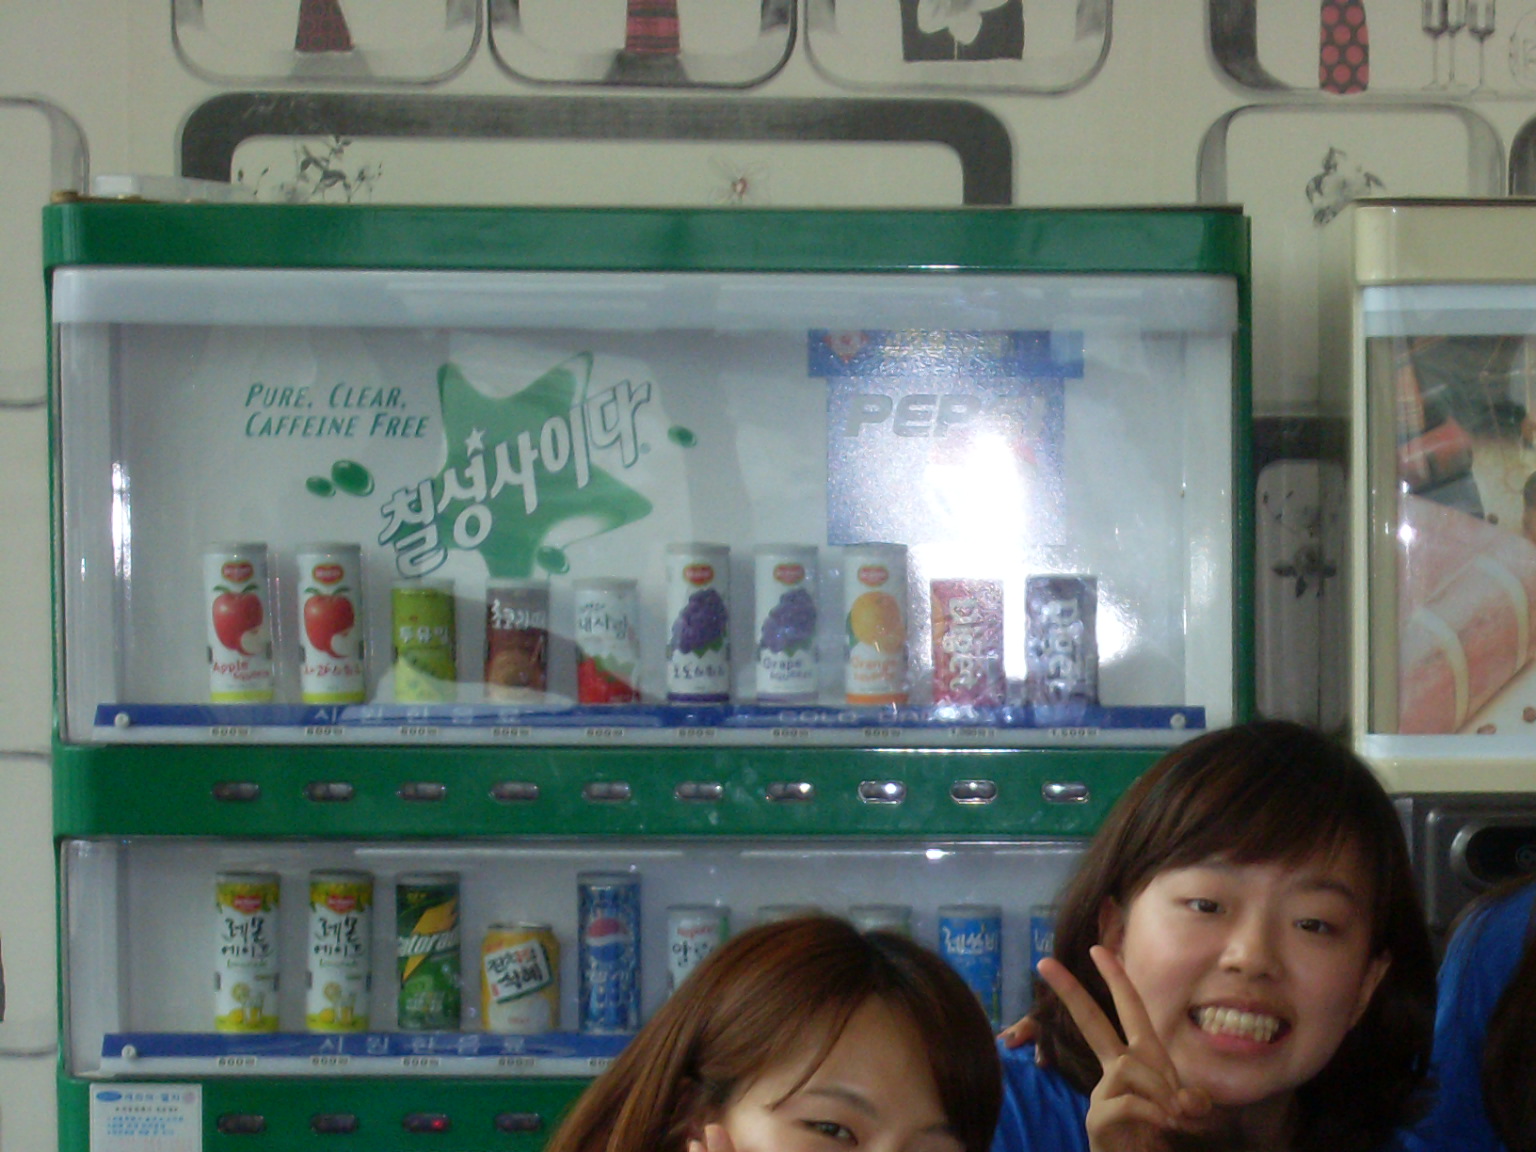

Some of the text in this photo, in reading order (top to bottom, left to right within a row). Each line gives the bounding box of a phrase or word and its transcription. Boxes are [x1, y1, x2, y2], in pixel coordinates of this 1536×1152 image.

[245, 412, 431, 438] CAFFEINE FREE
[378, 378, 652, 580] 칠성사이다
